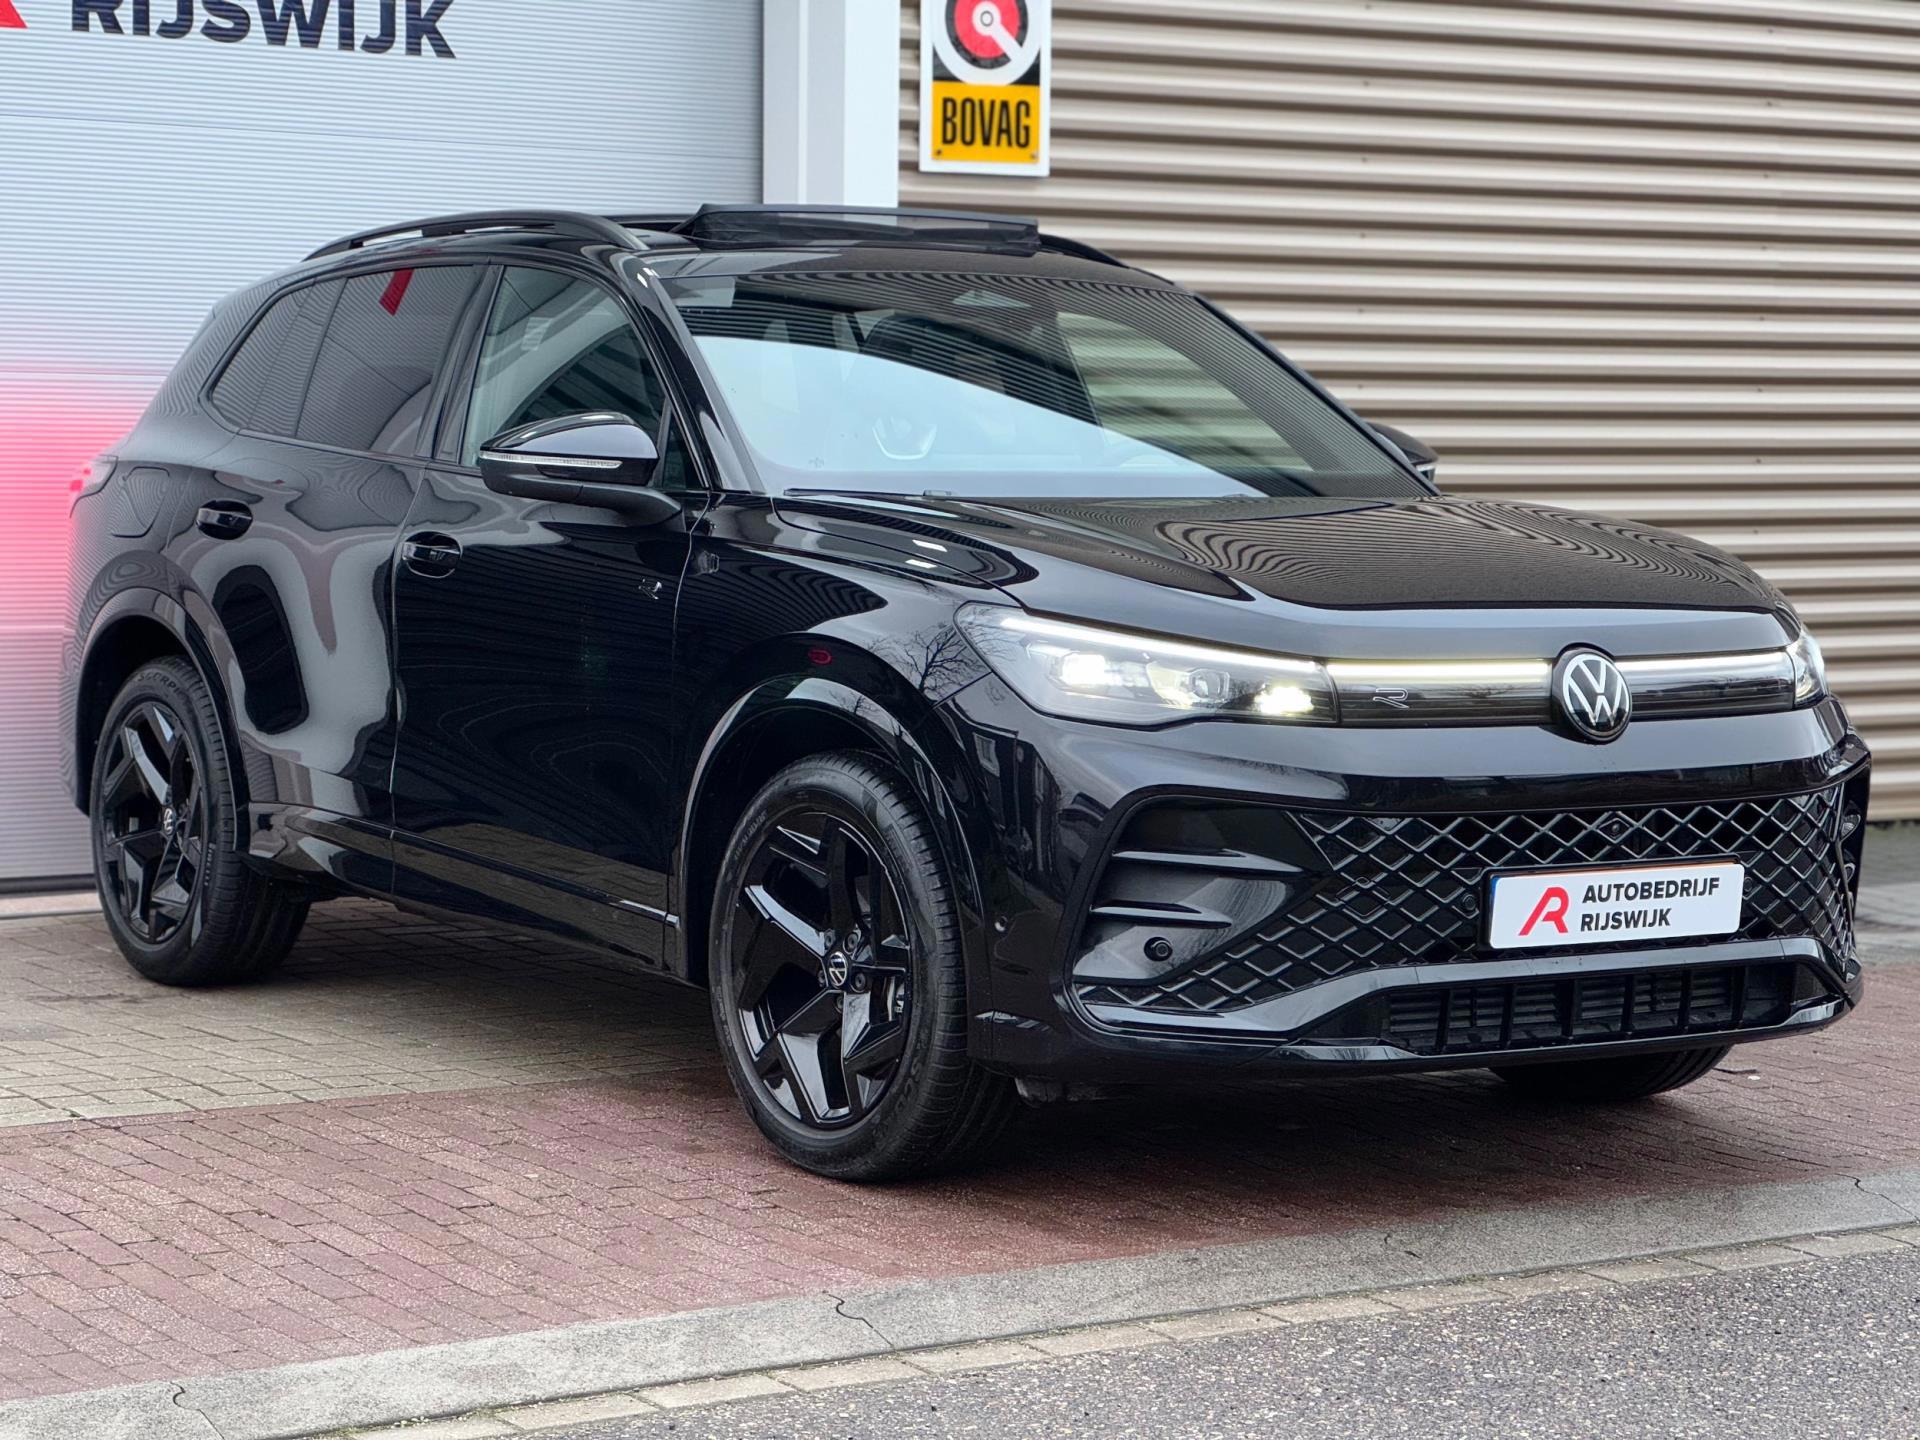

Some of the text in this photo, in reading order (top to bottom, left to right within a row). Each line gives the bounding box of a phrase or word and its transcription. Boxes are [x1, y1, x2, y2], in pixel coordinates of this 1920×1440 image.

[71, 0, 457, 59] RIJSWIJK
[941, 97, 1031, 148] BOVAG
[1582, 877, 1720, 904] AUTOBEDRIJF
[1580, 908, 1672, 932] RIJSWIJK
